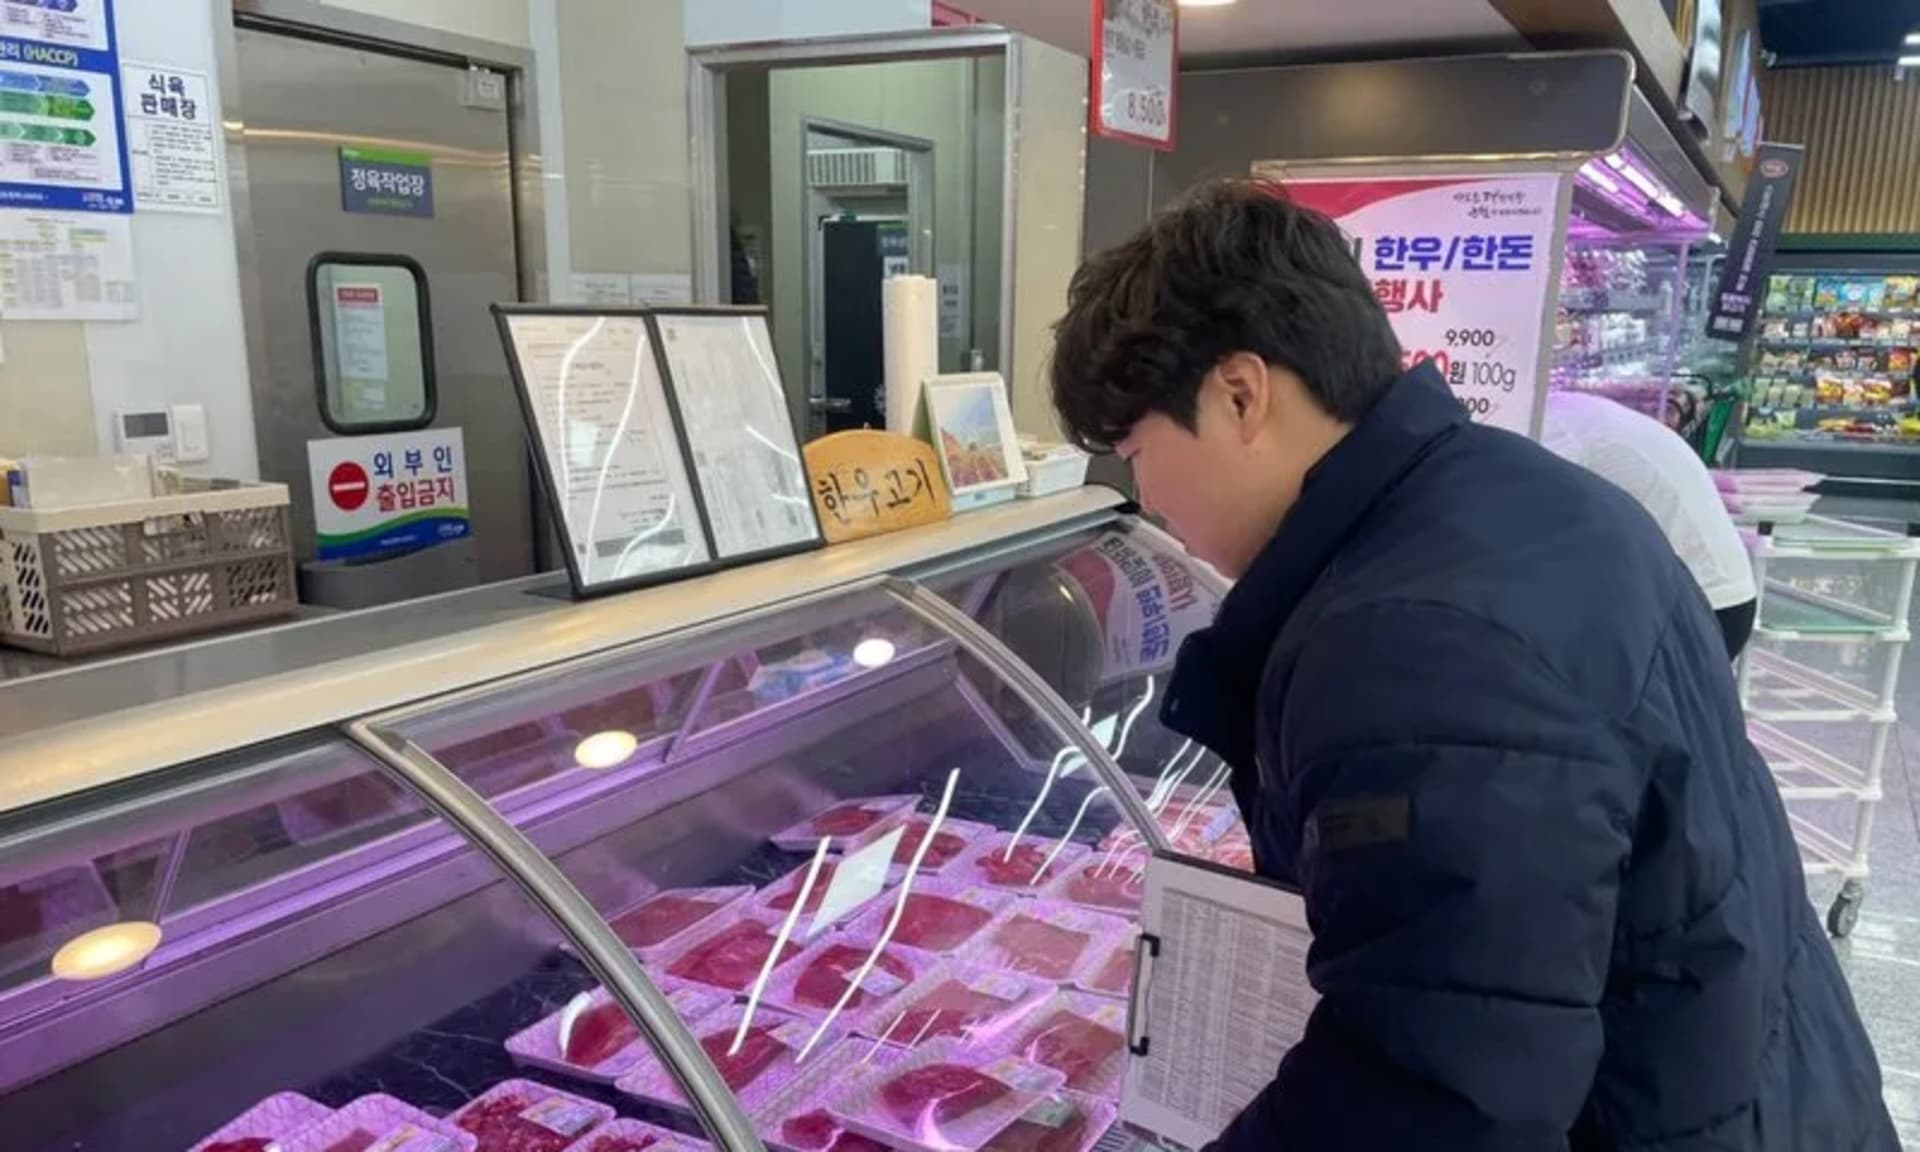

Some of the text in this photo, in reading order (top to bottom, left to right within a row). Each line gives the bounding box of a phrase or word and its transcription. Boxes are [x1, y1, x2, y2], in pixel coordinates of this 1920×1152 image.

[23, 44, 77, 67] (HACCP)
[149, 73, 185, 96] 식육
[141, 93, 196, 120] 판매장
[351, 167, 425, 197] 정육작업장
[1374, 234, 1534, 272] 한우/한돈
[1445, 329, 1495, 347] 9,900
[1473, 361, 1516, 392] 100g
[1457, 397, 1489, 414] 00
[376, 476, 455, 513] 출입금지
